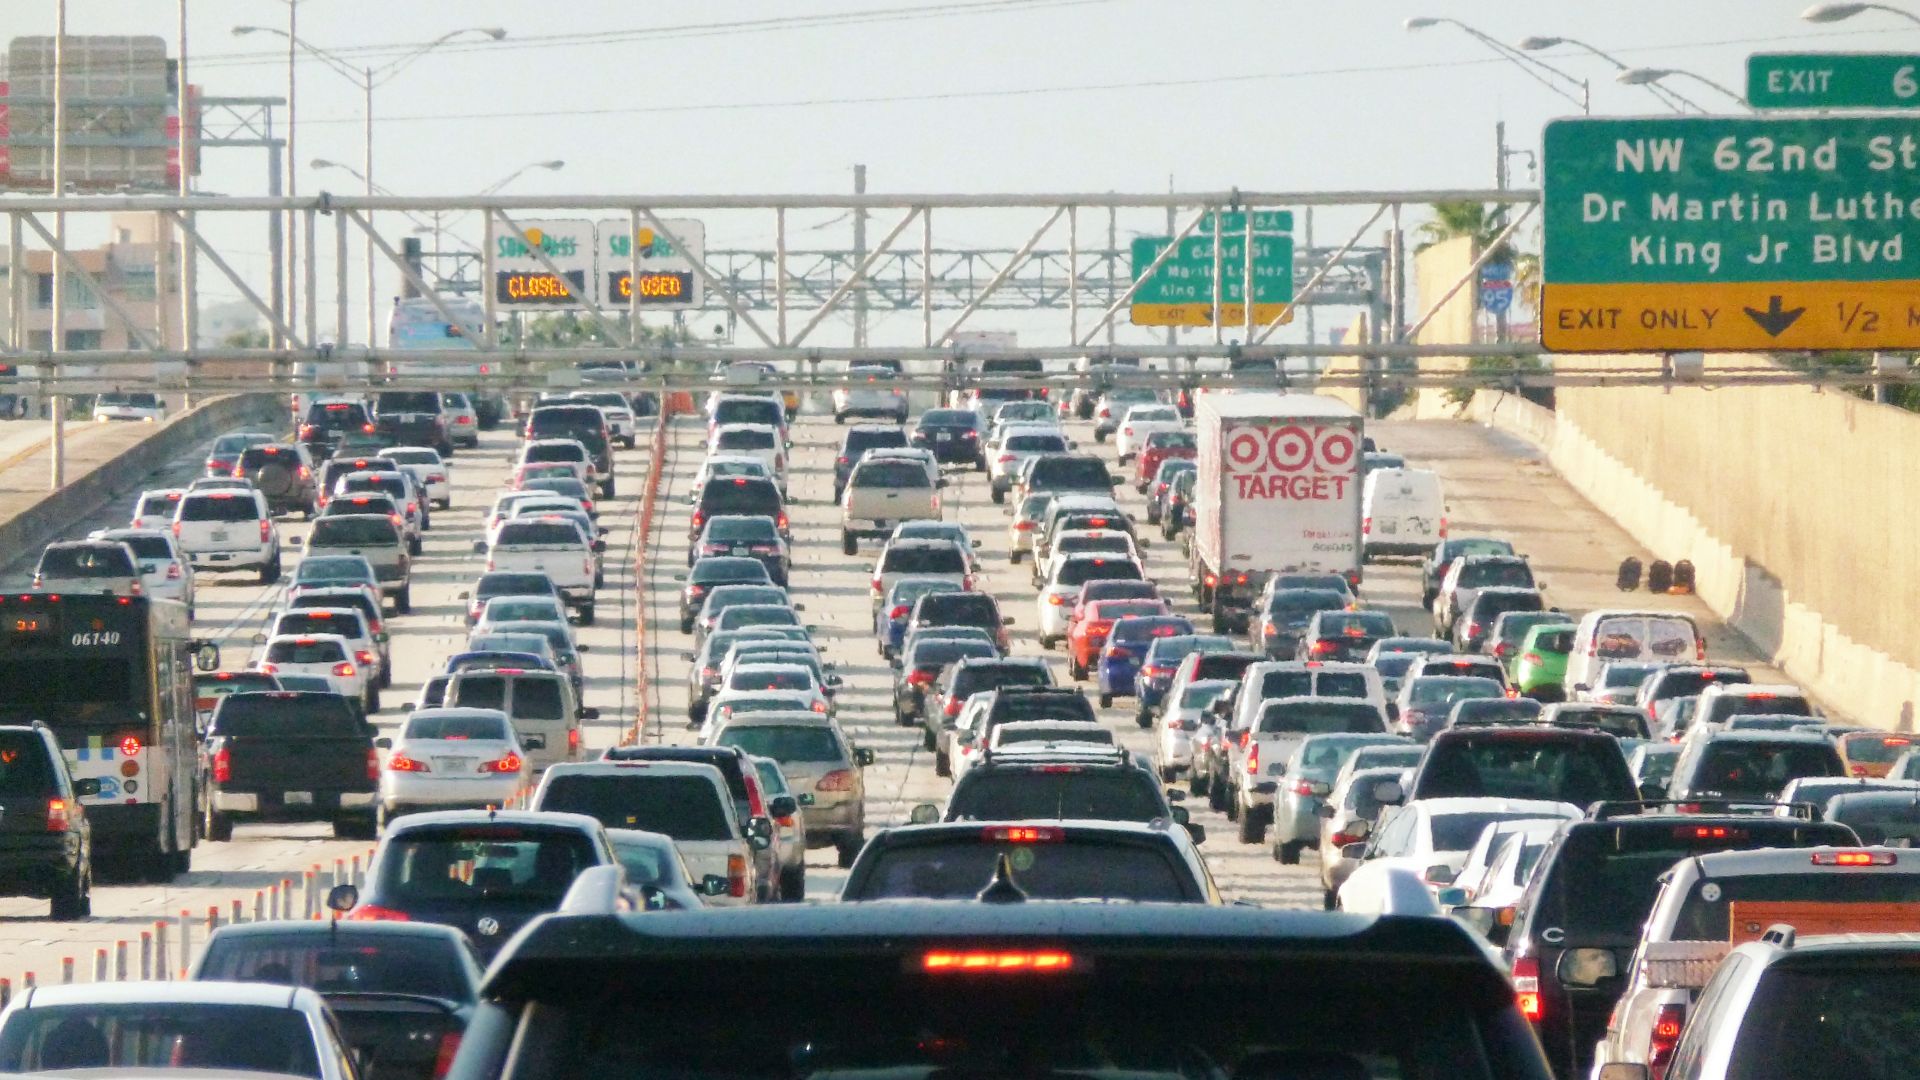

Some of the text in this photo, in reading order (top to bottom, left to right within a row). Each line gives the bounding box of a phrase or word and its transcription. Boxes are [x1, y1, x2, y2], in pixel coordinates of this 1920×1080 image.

[1768, 69, 1833, 93] EXIT
[1616, 135, 1917, 172] NW 62nd St
[1583, 192, 1626, 223] Dr
[1651, 192, 1788, 222] Martin
[1630, 233, 1903, 273] King Jr Blvd
[1558, 308, 1622, 330] EXIT
[1640, 308, 1720, 330] ONLY
[1838, 301, 1880, 334] 1/2
[1233, 474, 1350, 500] TARGET
[71, 631, 120, 646] 06740
